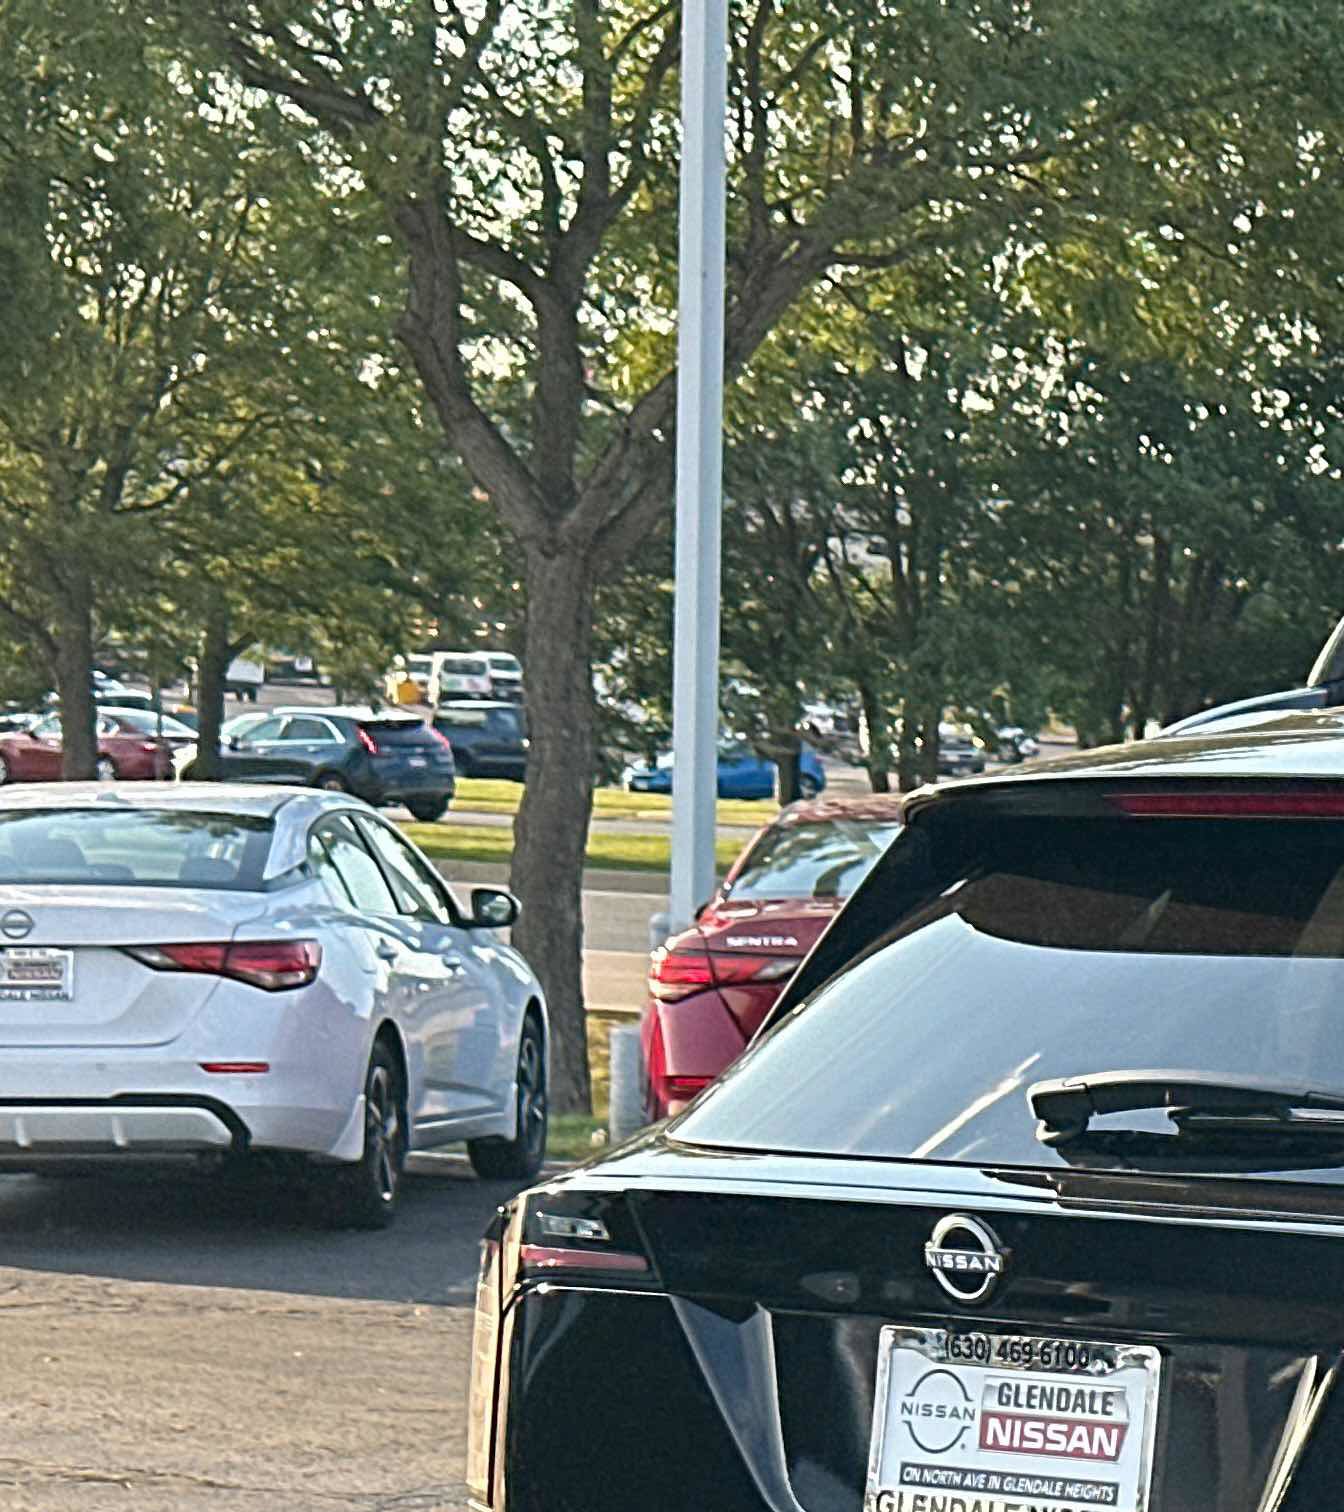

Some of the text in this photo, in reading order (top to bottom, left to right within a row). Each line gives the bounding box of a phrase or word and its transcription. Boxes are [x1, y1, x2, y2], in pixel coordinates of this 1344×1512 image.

[925, 1251, 1001, 1272] NISSAN
[945, 1334, 1091, 1369] (630) 469-6100
[901, 1401, 976, 1421] NISSAN
[997, 1382, 1115, 1416] GLENDALE
[986, 1417, 1120, 1457] NISSAN
[902, 1467, 1116, 1502] ON NORTH AVE IN GLENDALE HEIGHTS
